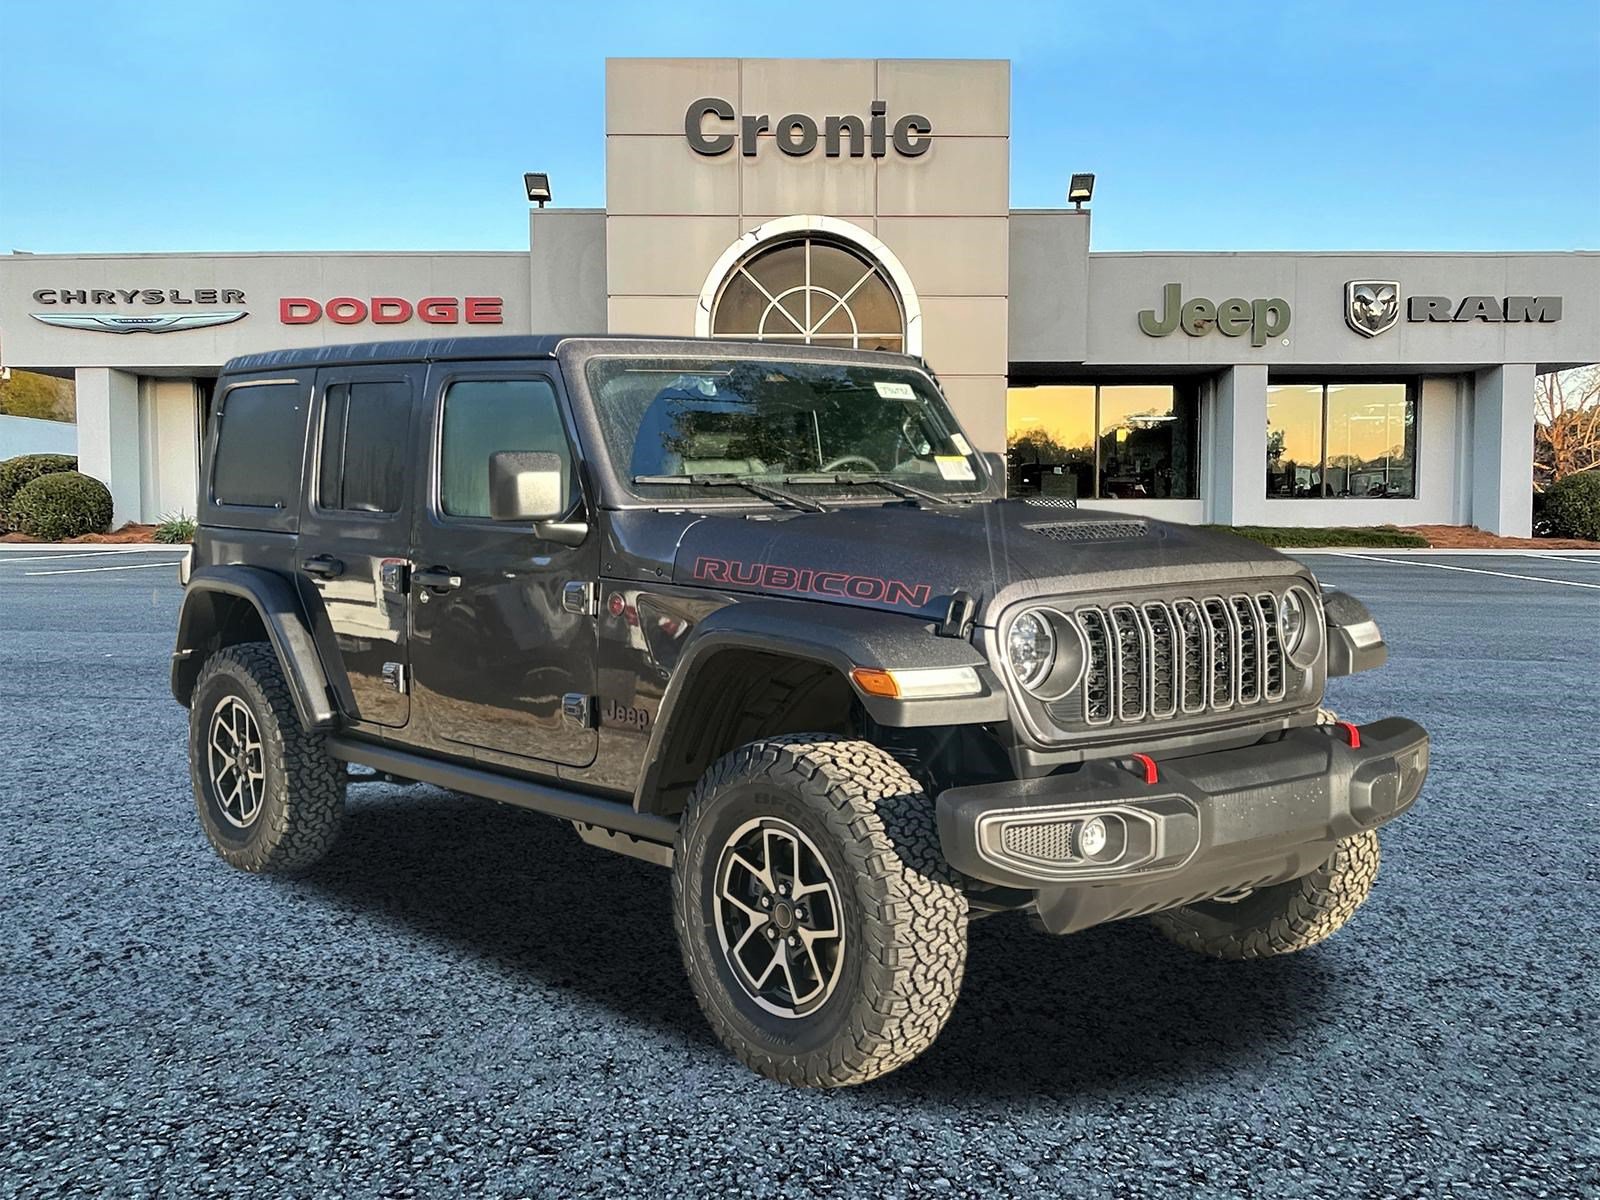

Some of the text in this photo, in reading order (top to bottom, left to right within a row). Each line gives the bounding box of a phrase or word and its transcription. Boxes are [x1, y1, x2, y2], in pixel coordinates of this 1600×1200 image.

[685, 97, 932, 157] Cronic
[33, 288, 247, 304] CHRYSLER
[279, 297, 504, 325] DODGE
[1407, 296, 1563, 322] RAM
[1137, 283, 1292, 347] Jeep
[693, 556, 932, 608] RUBICON
[606, 699, 650, 730] Jeep
